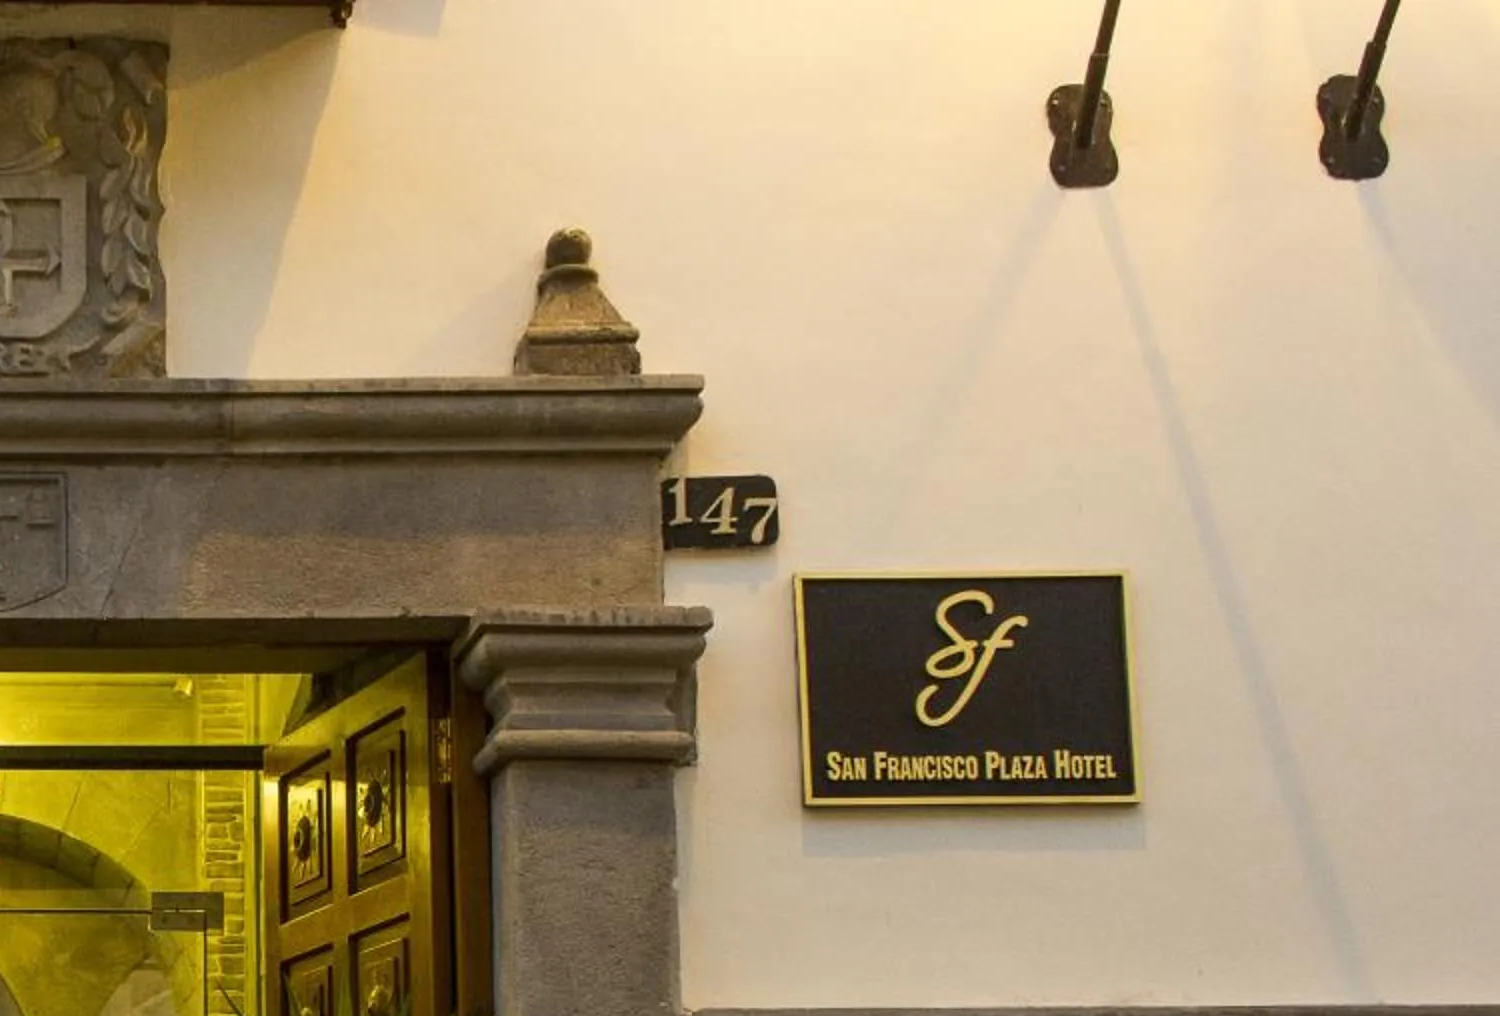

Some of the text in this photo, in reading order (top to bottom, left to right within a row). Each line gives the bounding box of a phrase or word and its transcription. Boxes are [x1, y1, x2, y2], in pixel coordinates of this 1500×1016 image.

[667, 476, 778, 545] 147
[826, 749, 1117, 781] SAN FRANCISCO PLAZA HOTEL
